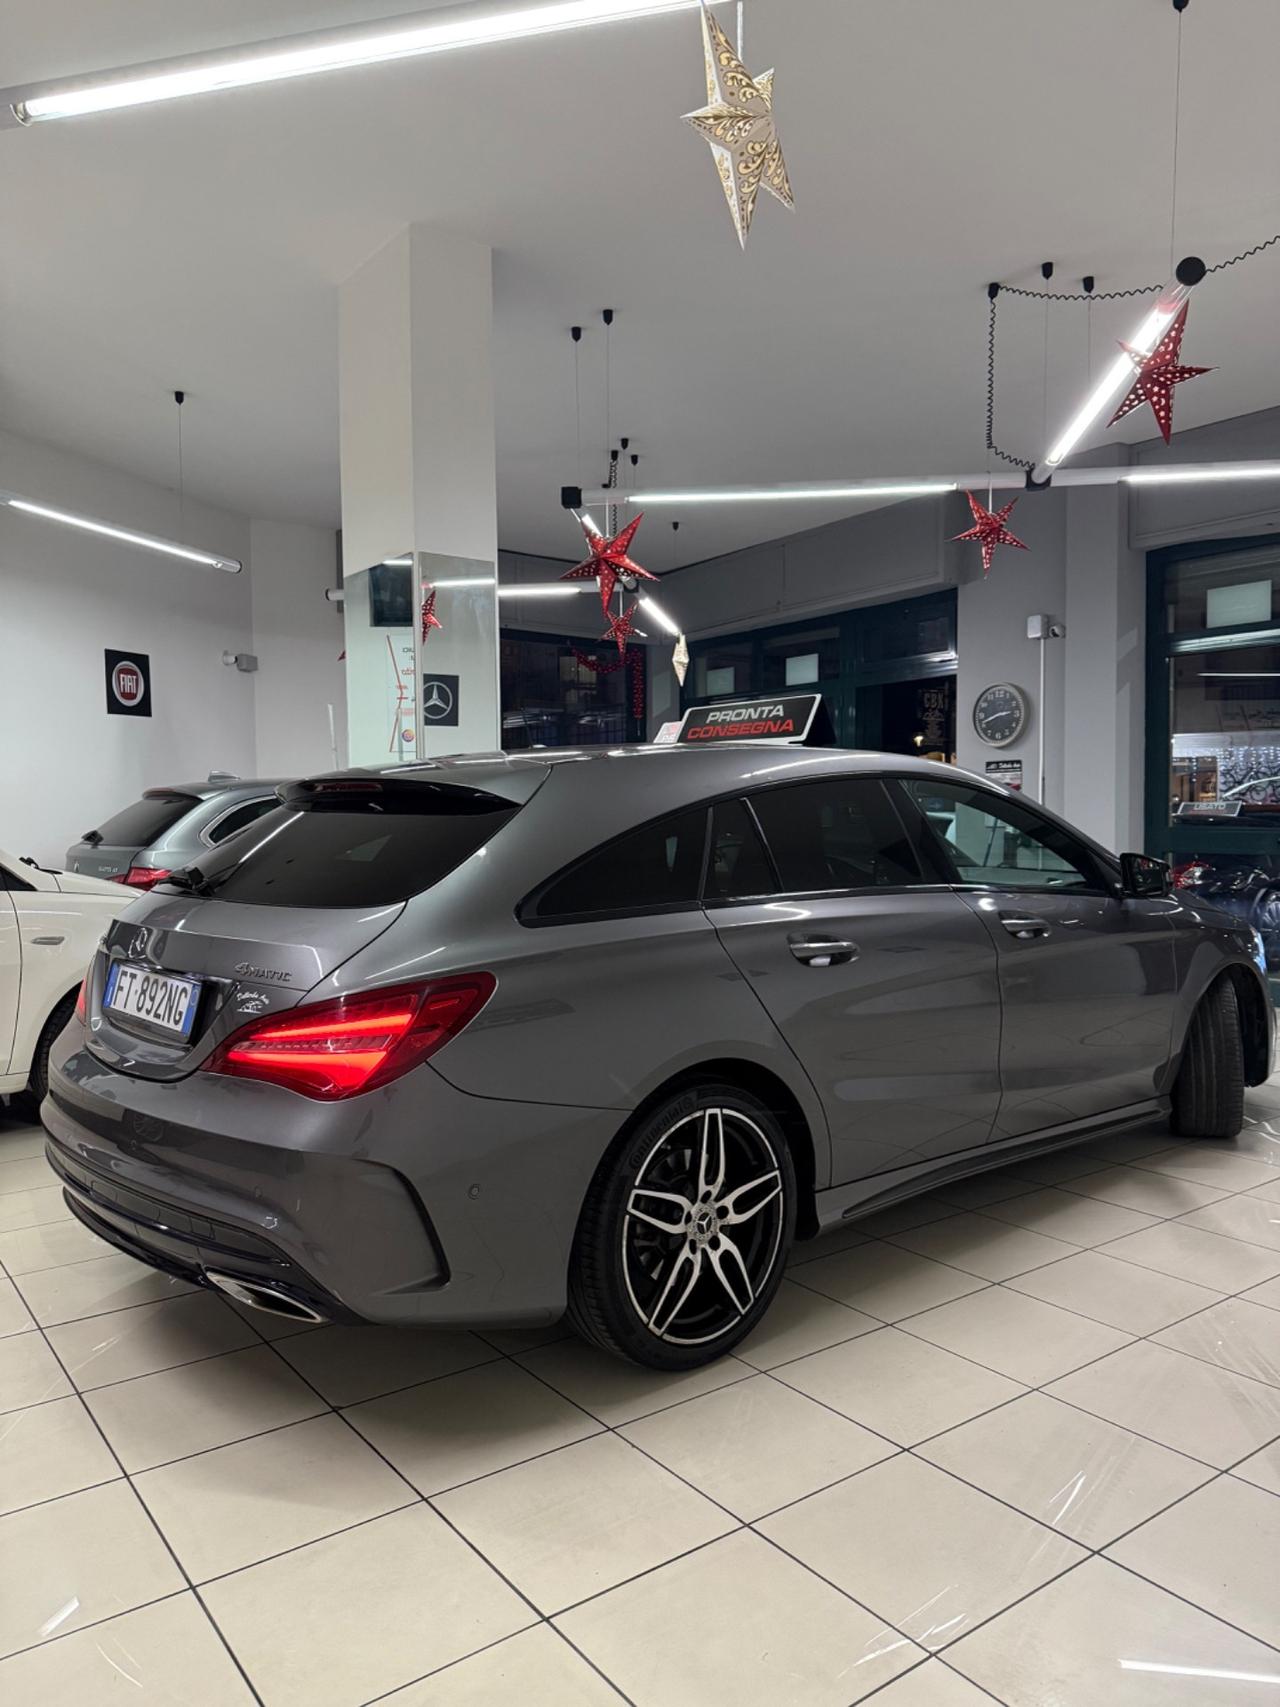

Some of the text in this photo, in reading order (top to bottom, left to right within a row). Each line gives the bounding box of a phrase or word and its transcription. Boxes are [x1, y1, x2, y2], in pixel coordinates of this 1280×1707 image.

[119, 673, 137, 694] FIAT
[705, 703, 785, 724] PRONTA
[686, 718, 794, 740] CONSEGNA
[235, 961, 292, 982] 4MATIC
